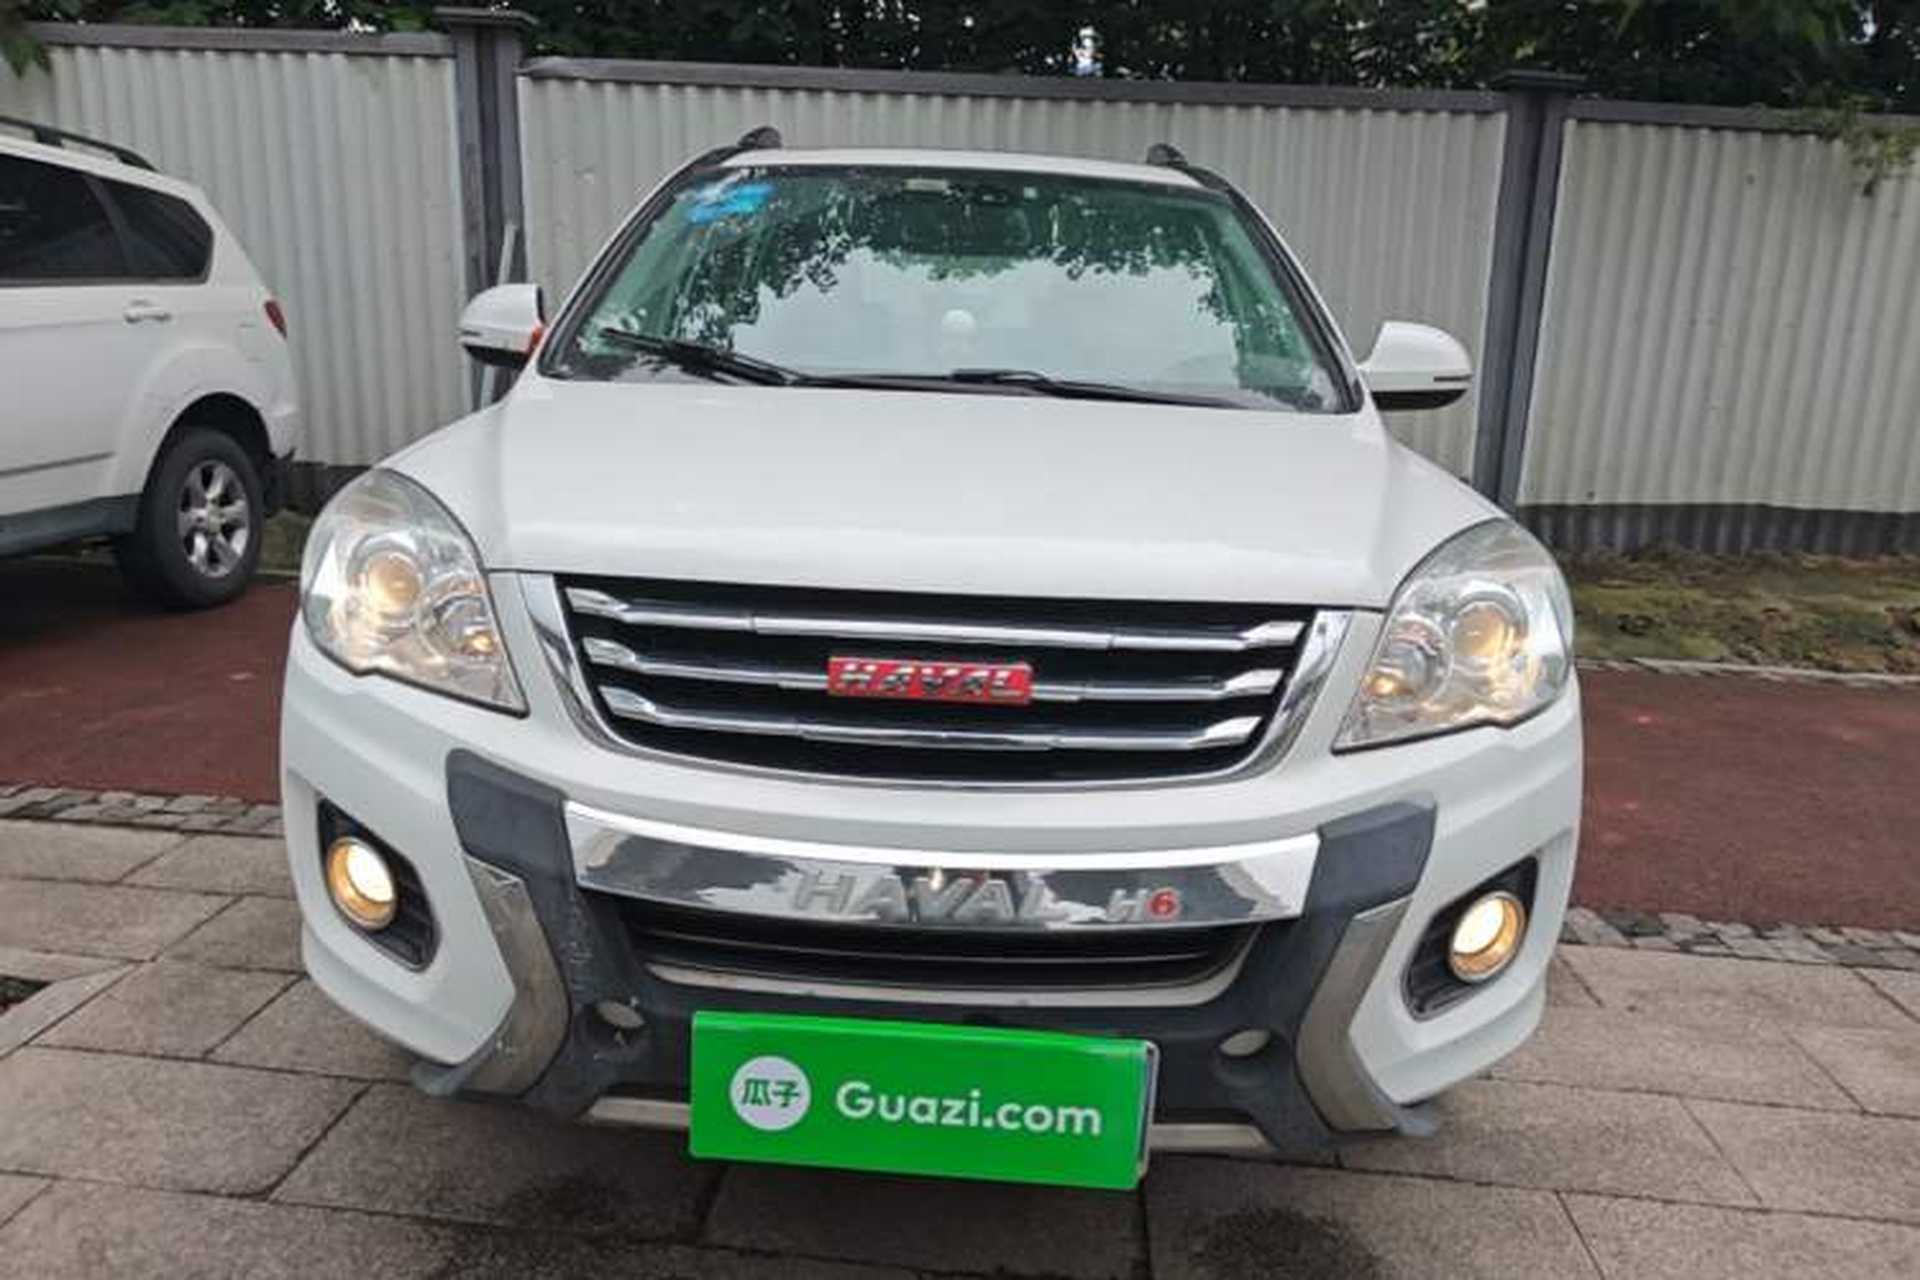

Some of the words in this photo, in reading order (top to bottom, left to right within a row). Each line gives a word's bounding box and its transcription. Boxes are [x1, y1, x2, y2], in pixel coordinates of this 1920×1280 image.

[837, 662, 1028, 698] HAVAL
[792, 872, 1070, 926] HAVAL
[1106, 887, 1181, 921] H6
[740, 1077, 800, 1108] 瓜子
[836, 1081, 1102, 1136] Guazi.com
